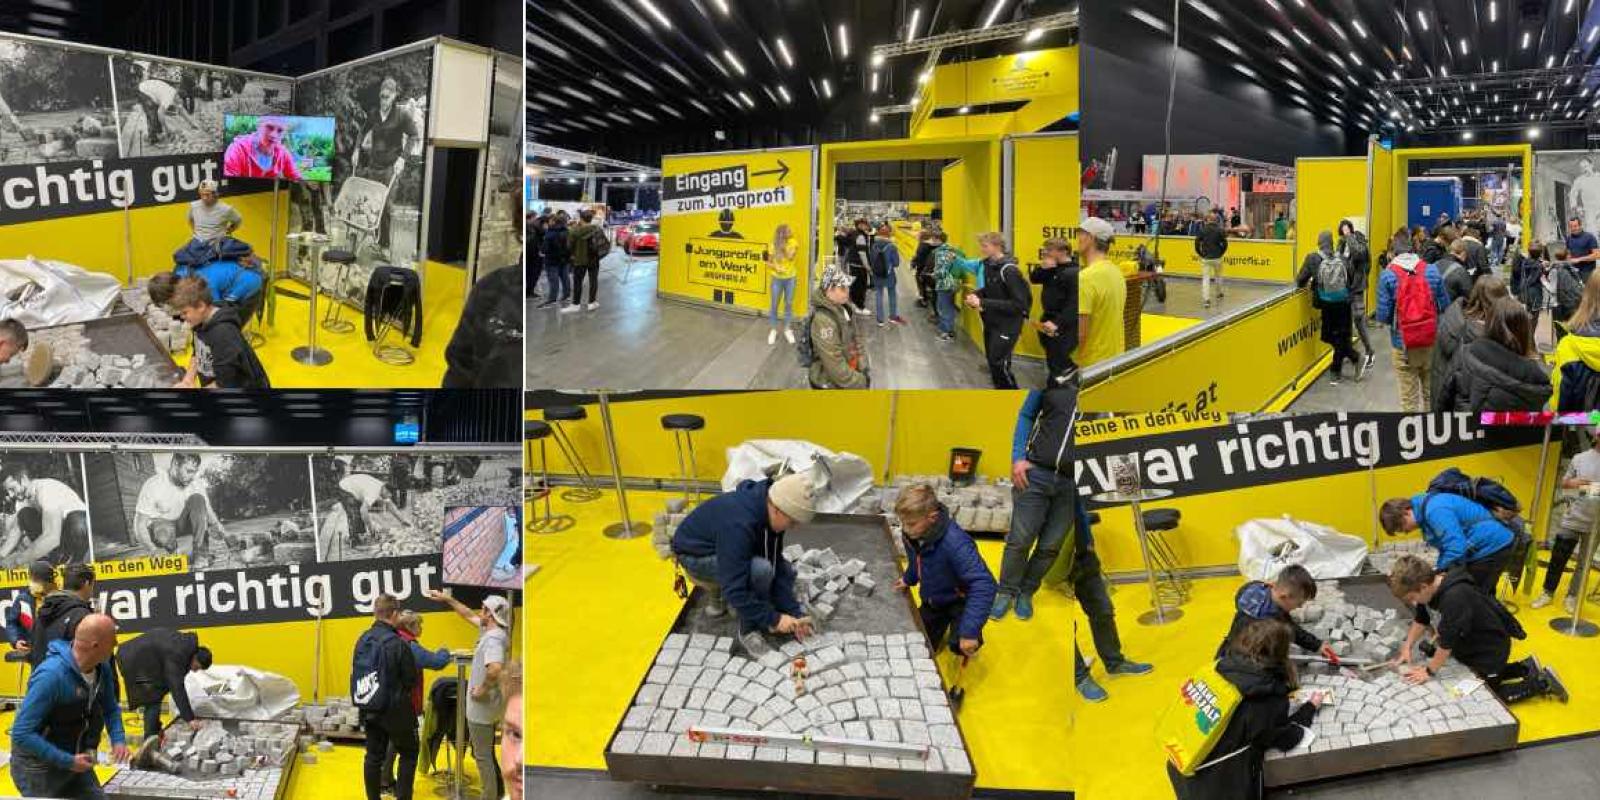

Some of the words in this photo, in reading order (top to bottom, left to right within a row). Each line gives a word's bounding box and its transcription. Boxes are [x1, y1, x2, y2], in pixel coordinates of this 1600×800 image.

[151, 158, 230, 202] gut.
[675, 168, 746, 192] Eingang
[677, 198, 705, 212] zum
[709, 185, 786, 209] Jungprofi
[1123, 413, 1140, 431] in
[1145, 404, 1178, 428] den
[1217, 411, 1381, 475] richtig
[1397, 411, 1485, 460] gut.
[100, 564, 114, 575] in
[118, 560, 145, 573] den
[150, 556, 183, 571] Weg
[175, 564, 333, 617] richtig
[356, 671, 378, 696] NIKE
